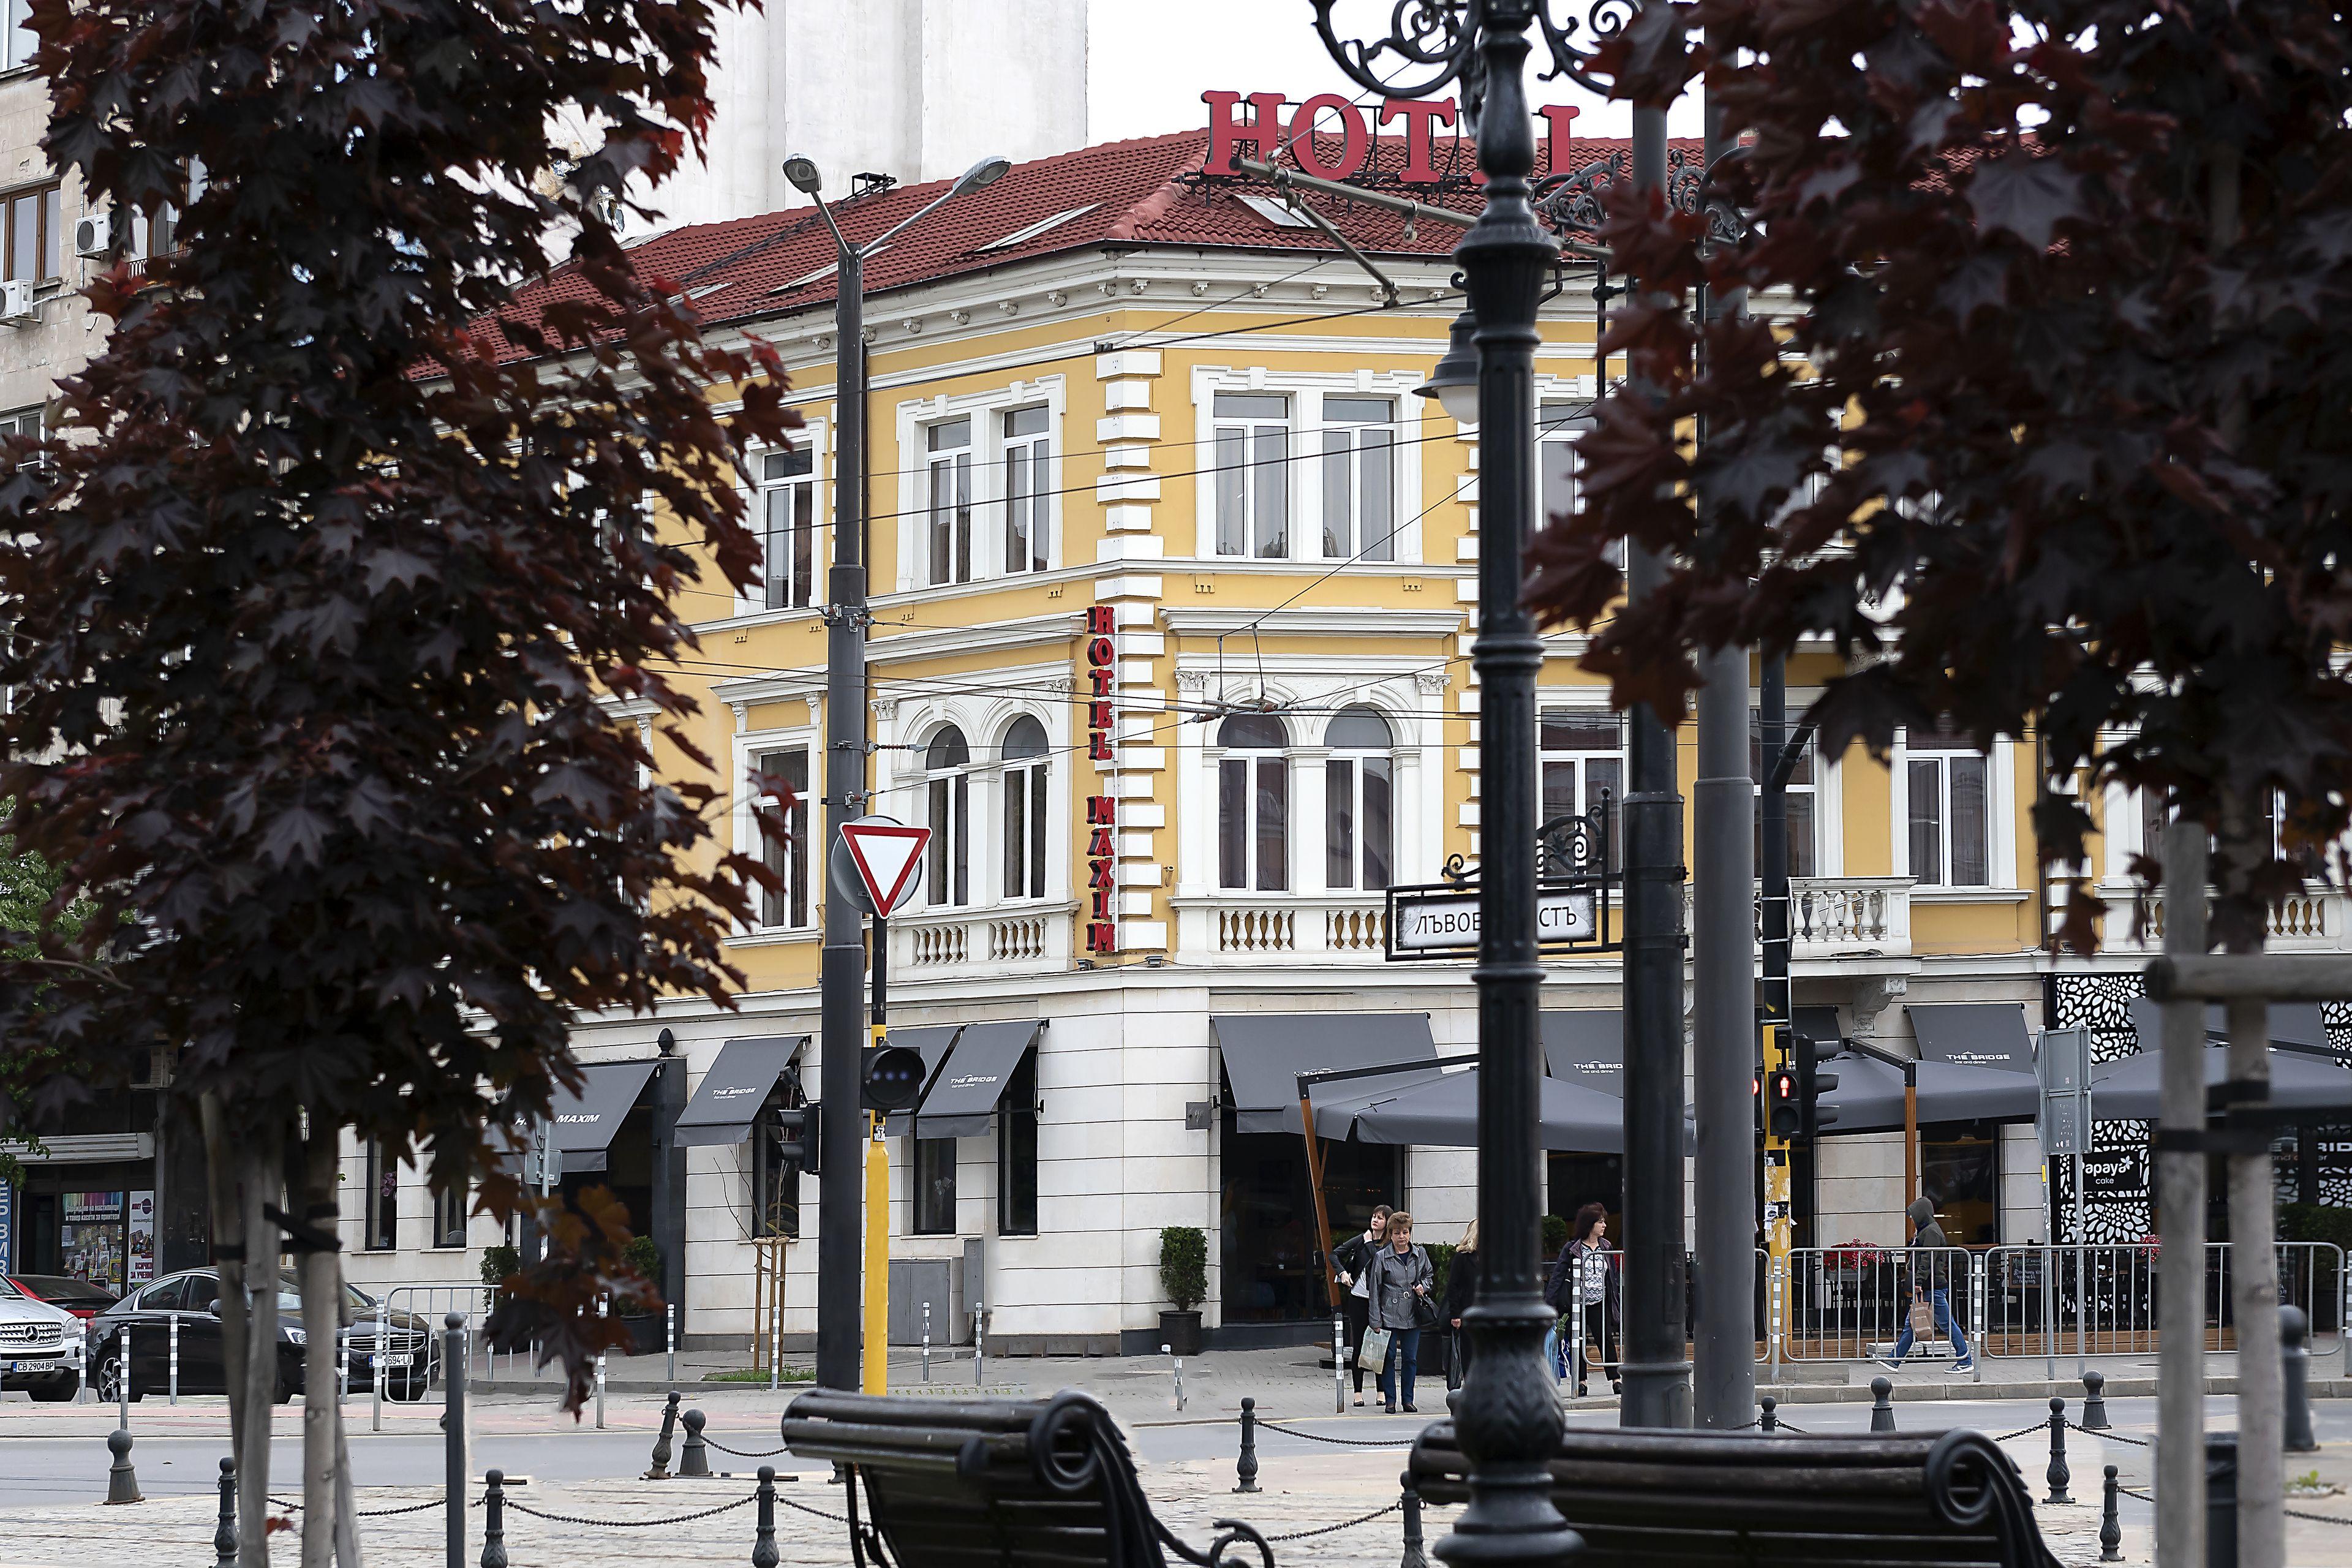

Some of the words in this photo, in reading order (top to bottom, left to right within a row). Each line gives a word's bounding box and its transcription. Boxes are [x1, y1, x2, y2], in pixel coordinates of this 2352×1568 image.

[1200, 90, 1600, 187] HOTL
[1087, 606, 1115, 761] HOTEL
[1086, 796, 1115, 952] MAXIM
[1415, 911, 1481, 935] ЛЪВОВ
[1539, 906, 1577, 927] СТЪ
[556, 1114, 601, 1123] MAXIM
[18, 1363, 28, 1371] CB
[28, 1362, 45, 1371] 2904
[45, 1362, 54, 1370] BP
